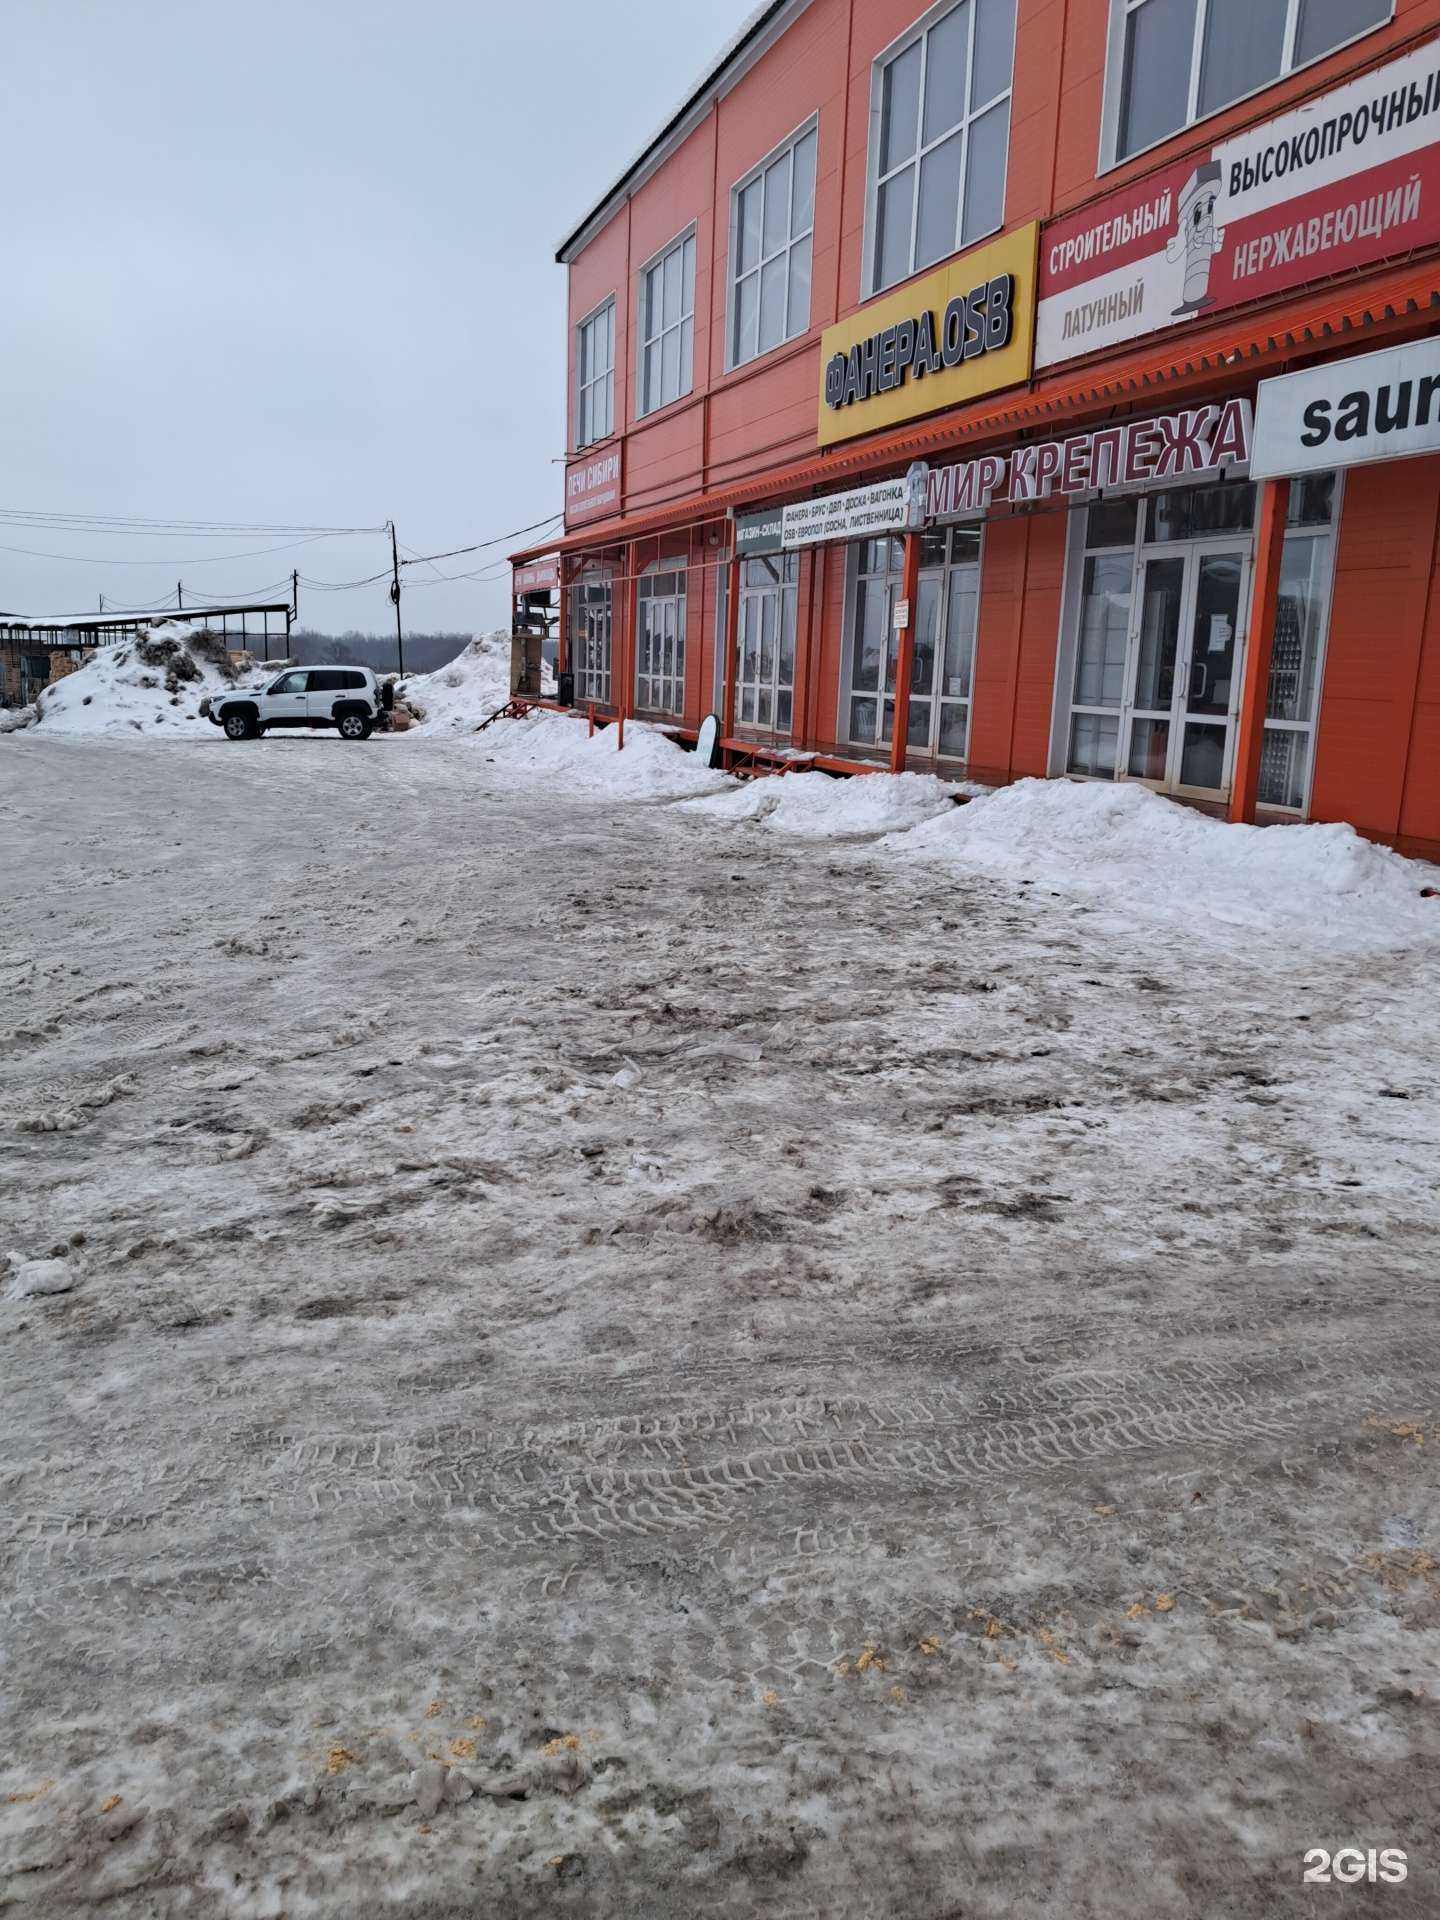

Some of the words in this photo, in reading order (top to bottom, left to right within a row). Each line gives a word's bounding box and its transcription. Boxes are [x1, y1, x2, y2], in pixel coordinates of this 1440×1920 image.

[1050, 187, 1172, 275] СТРОИТЕЛЬНЫЙ
[1233, 173, 1422, 280] НЕРЖАВЕЮЩИЙ
[825, 272, 1014, 409] ФАНЕРА.OSB
[1062, 277, 1144, 340] ЛАТУННЫЙ
[926, 456, 1003, 517] МИР
[1009, 398, 1249, 501] КРЕПЕЖА
